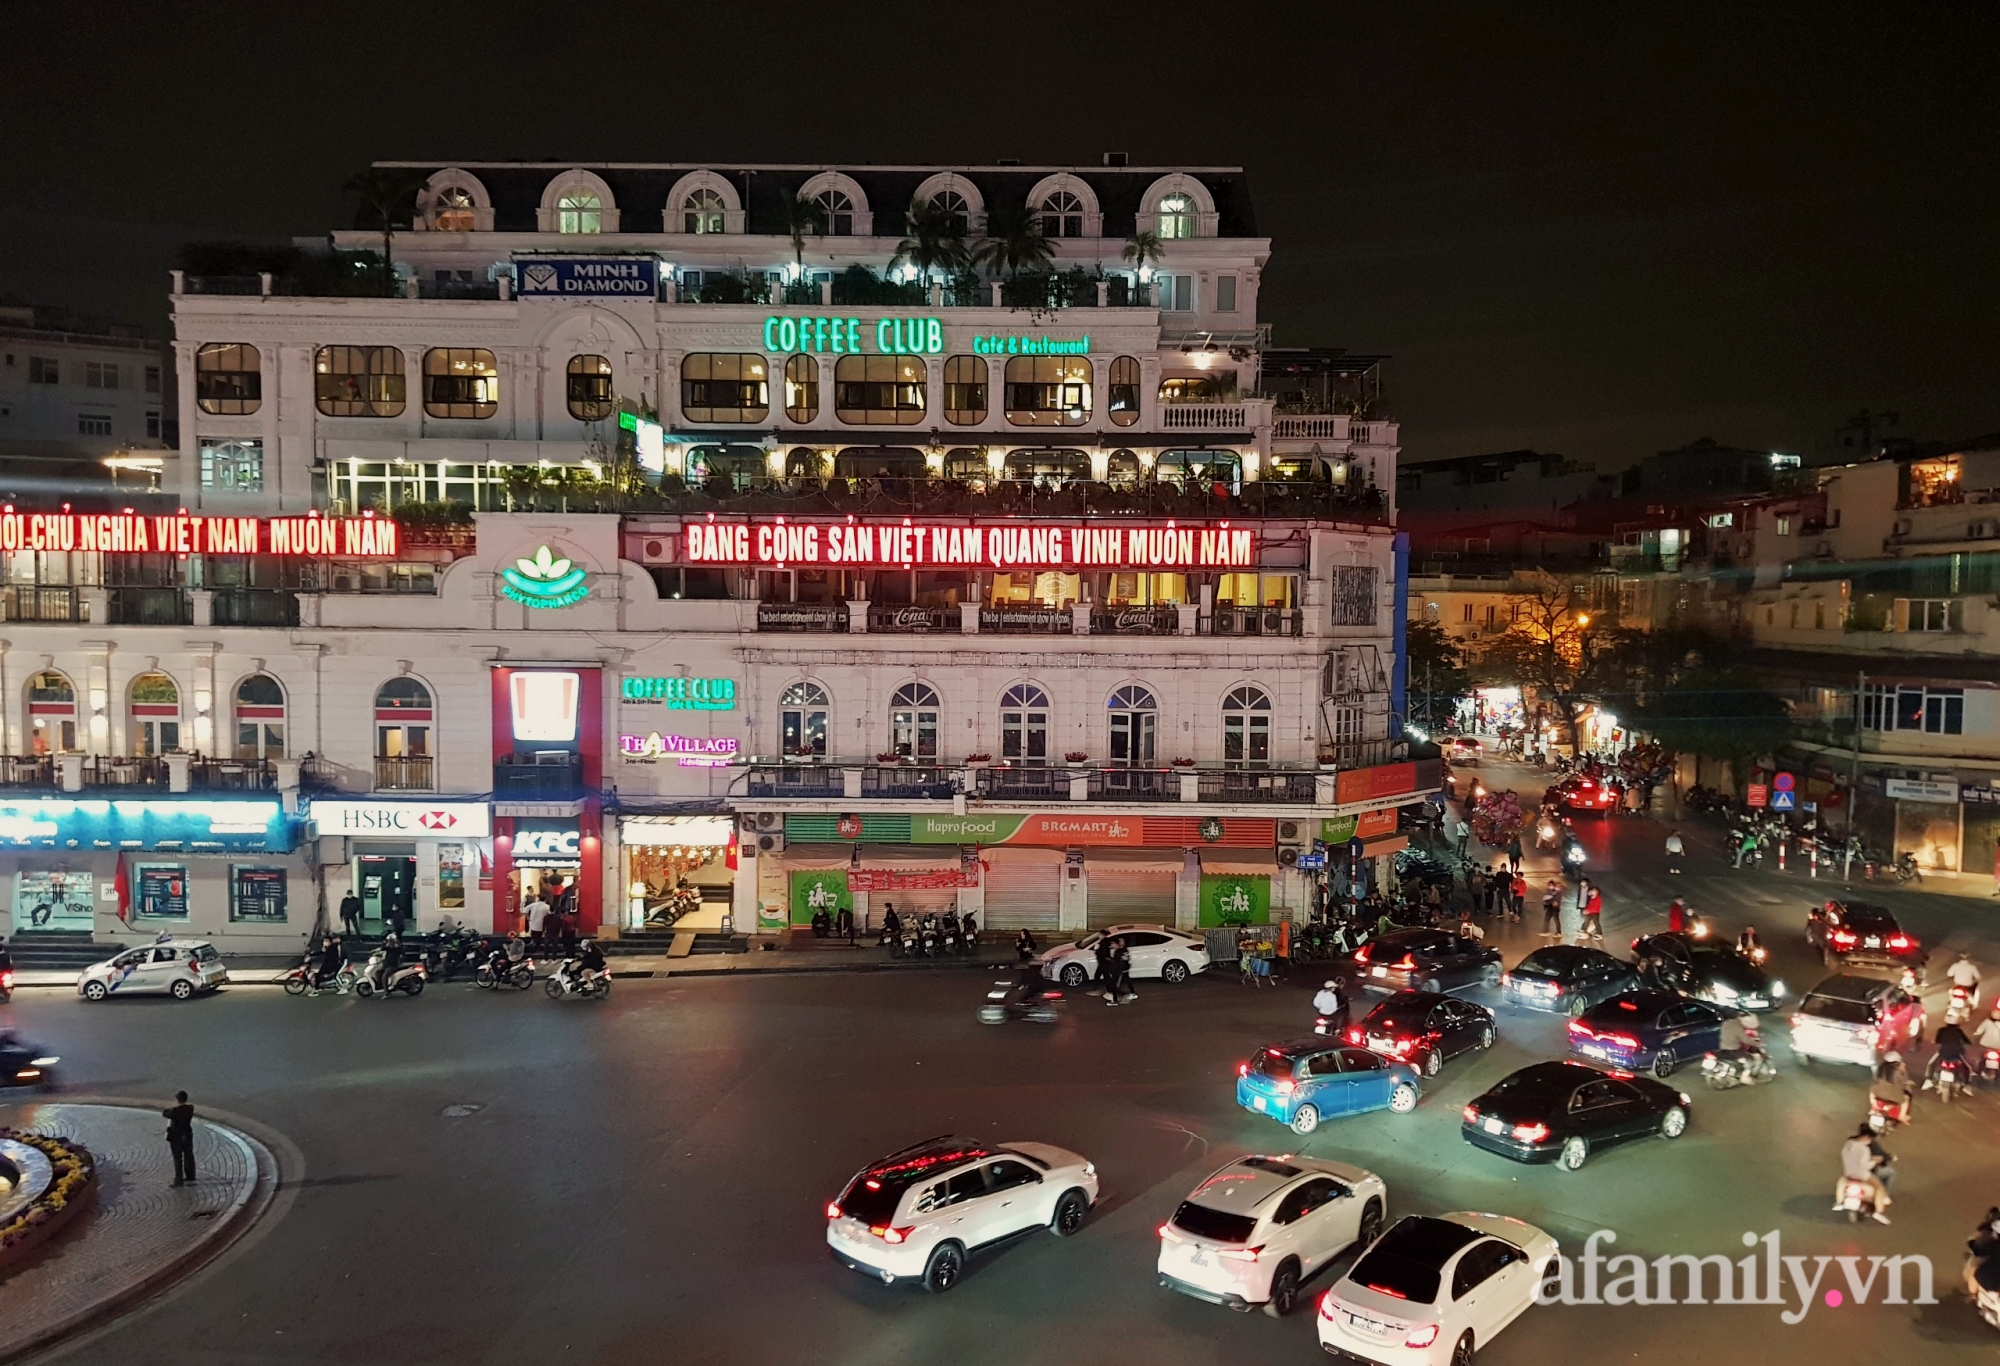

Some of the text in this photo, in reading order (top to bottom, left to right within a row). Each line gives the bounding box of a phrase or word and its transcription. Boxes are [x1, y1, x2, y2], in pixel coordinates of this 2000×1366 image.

[574, 264, 638, 277] MINH
[564, 279, 649, 292] DIAMOND
[764, 316, 943, 354] COFFEE CLUB
[1008, 336, 1019, 354] &
[1021, 335, 1090, 354] Restaurant
[0, 503, 396, 560] ỘI CHỦ NGHĨA VIỆT NAM MUÔN NĂM
[688, 513, 1251, 569] ĐẢNG CỘNG SẢN VIỆT NAM QUANG VINH MUÔN NĂM
[501, 585, 589, 609] PHYTOPHARCO
[760, 611, 768, 622] The
[982, 611, 991, 622] The
[623, 677, 735, 699] COFFEE CLUB
[344, 810, 410, 829] HSBC
[511, 831, 580, 854] KFC
